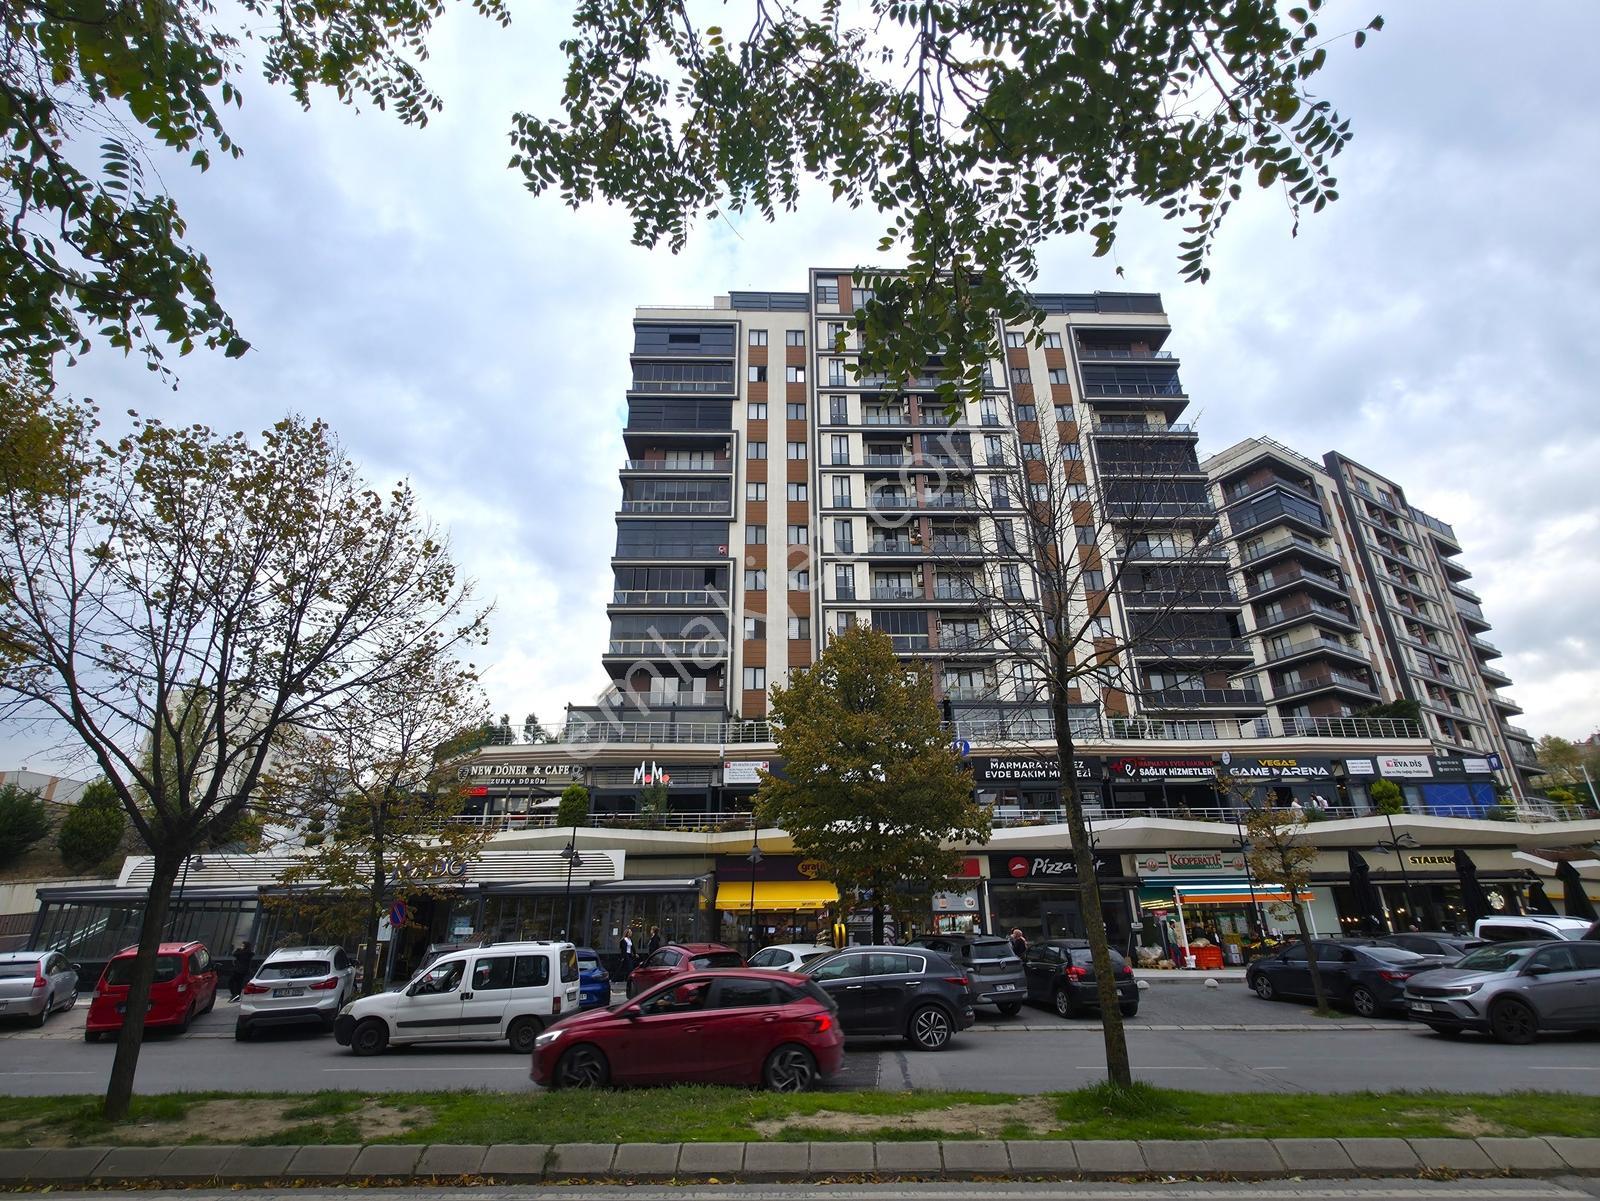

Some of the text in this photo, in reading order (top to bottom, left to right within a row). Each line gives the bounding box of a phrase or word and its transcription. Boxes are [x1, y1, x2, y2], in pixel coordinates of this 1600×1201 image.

[471, 762, 570, 775] NEW DÖNER & CAFE
[990, 761, 1042, 769] MARMARA
[1393, 760, 1409, 768] EVA
[985, 770, 1011, 778] EVDE
[1014, 770, 1046, 778] BAKIM
[1139, 766, 1215, 776] SAĞLIK HİZMETLERİ
[1229, 766, 1330, 776] GAME ARENA
[519, 777, 547, 785] DÜRÜM
[1031, 858, 1073, 876] Pizza
